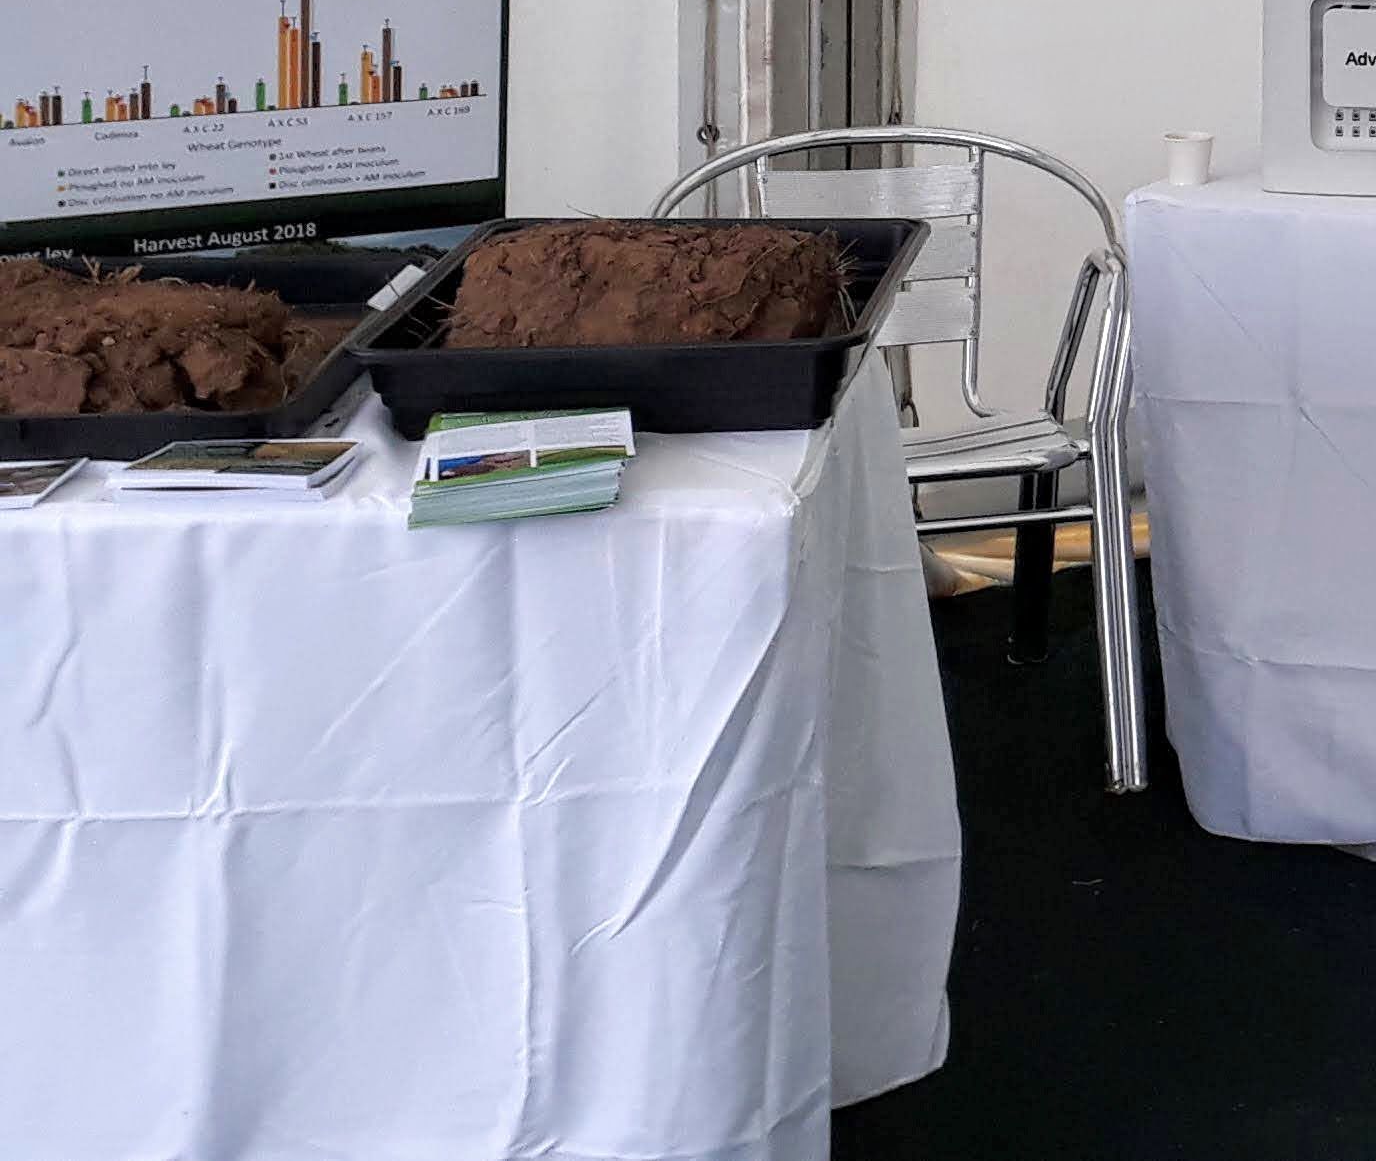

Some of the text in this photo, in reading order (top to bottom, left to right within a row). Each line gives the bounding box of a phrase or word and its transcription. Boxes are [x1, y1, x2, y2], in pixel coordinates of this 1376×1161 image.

[134, 222, 316, 253] Harvest August 2018
